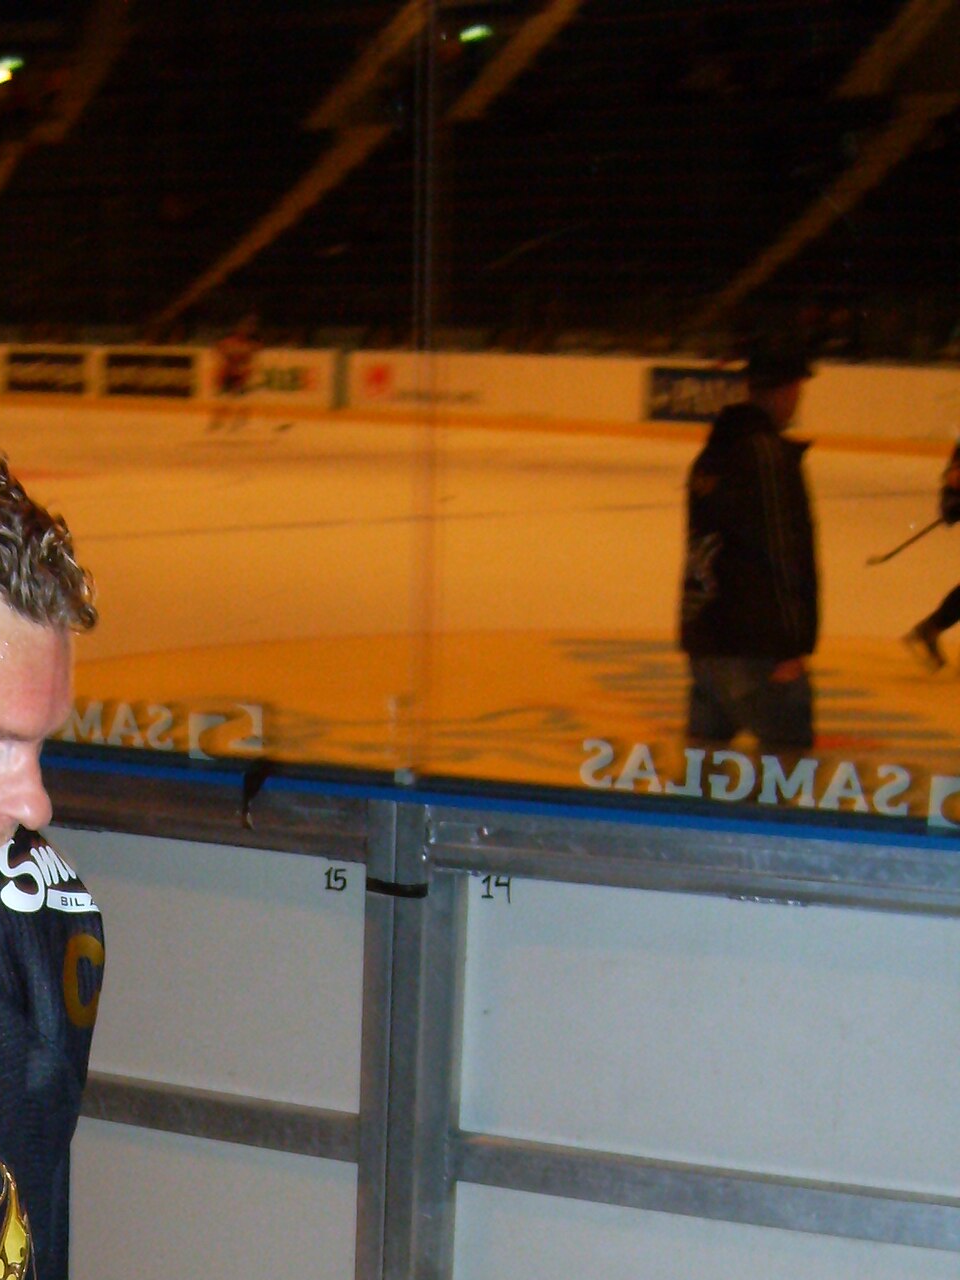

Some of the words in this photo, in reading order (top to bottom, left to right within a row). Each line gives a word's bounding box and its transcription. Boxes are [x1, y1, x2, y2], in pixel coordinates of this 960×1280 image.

[324, 866, 348, 892] 15
[481, 875, 511, 904] 14
[63, 933, 105, 1028] C
